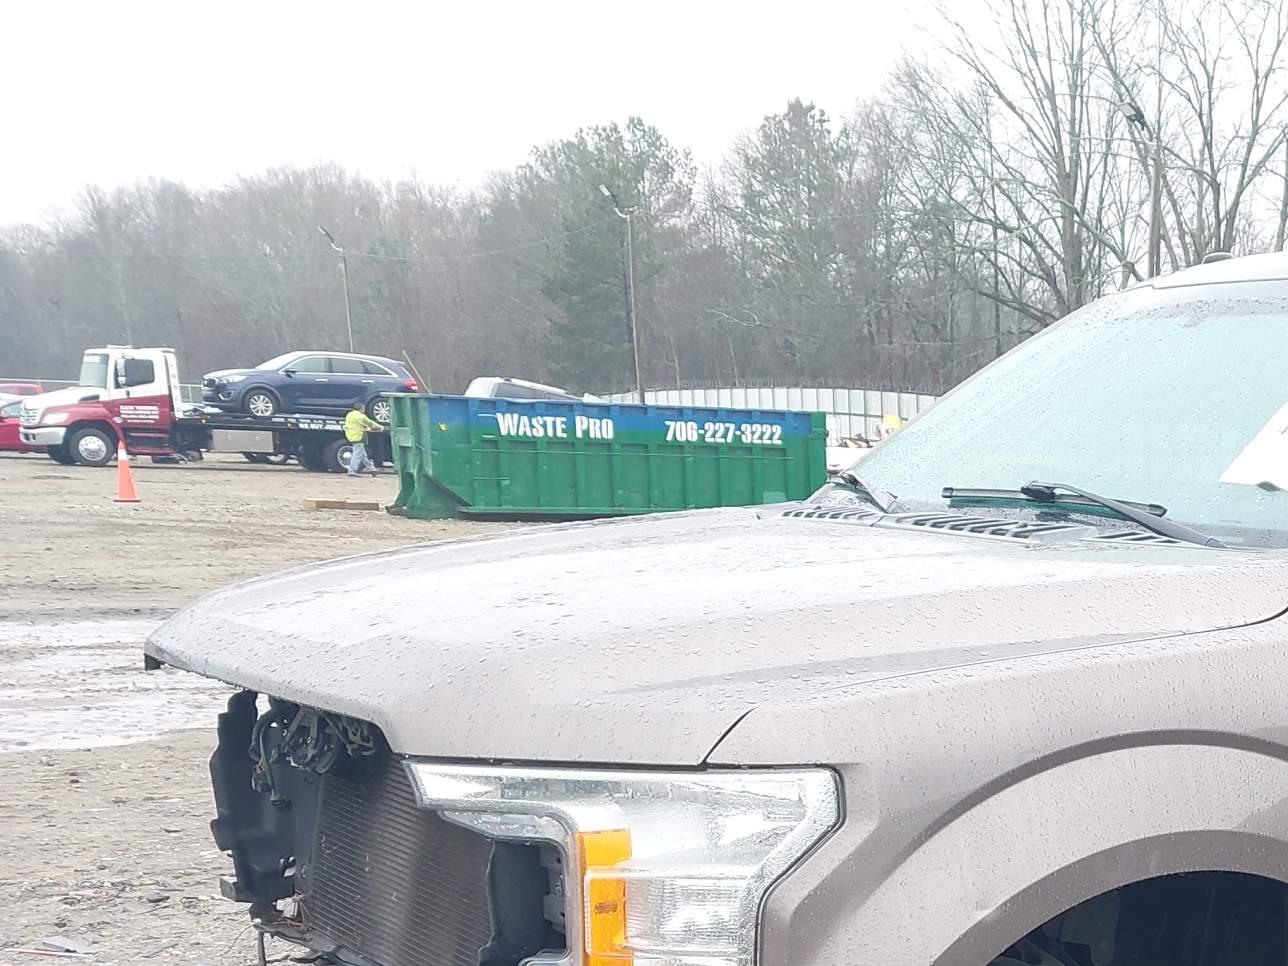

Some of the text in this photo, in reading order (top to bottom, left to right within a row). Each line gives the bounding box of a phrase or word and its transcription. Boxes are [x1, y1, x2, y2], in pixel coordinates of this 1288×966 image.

[496, 412, 783, 445] WASTE PRO 706-227-3222
